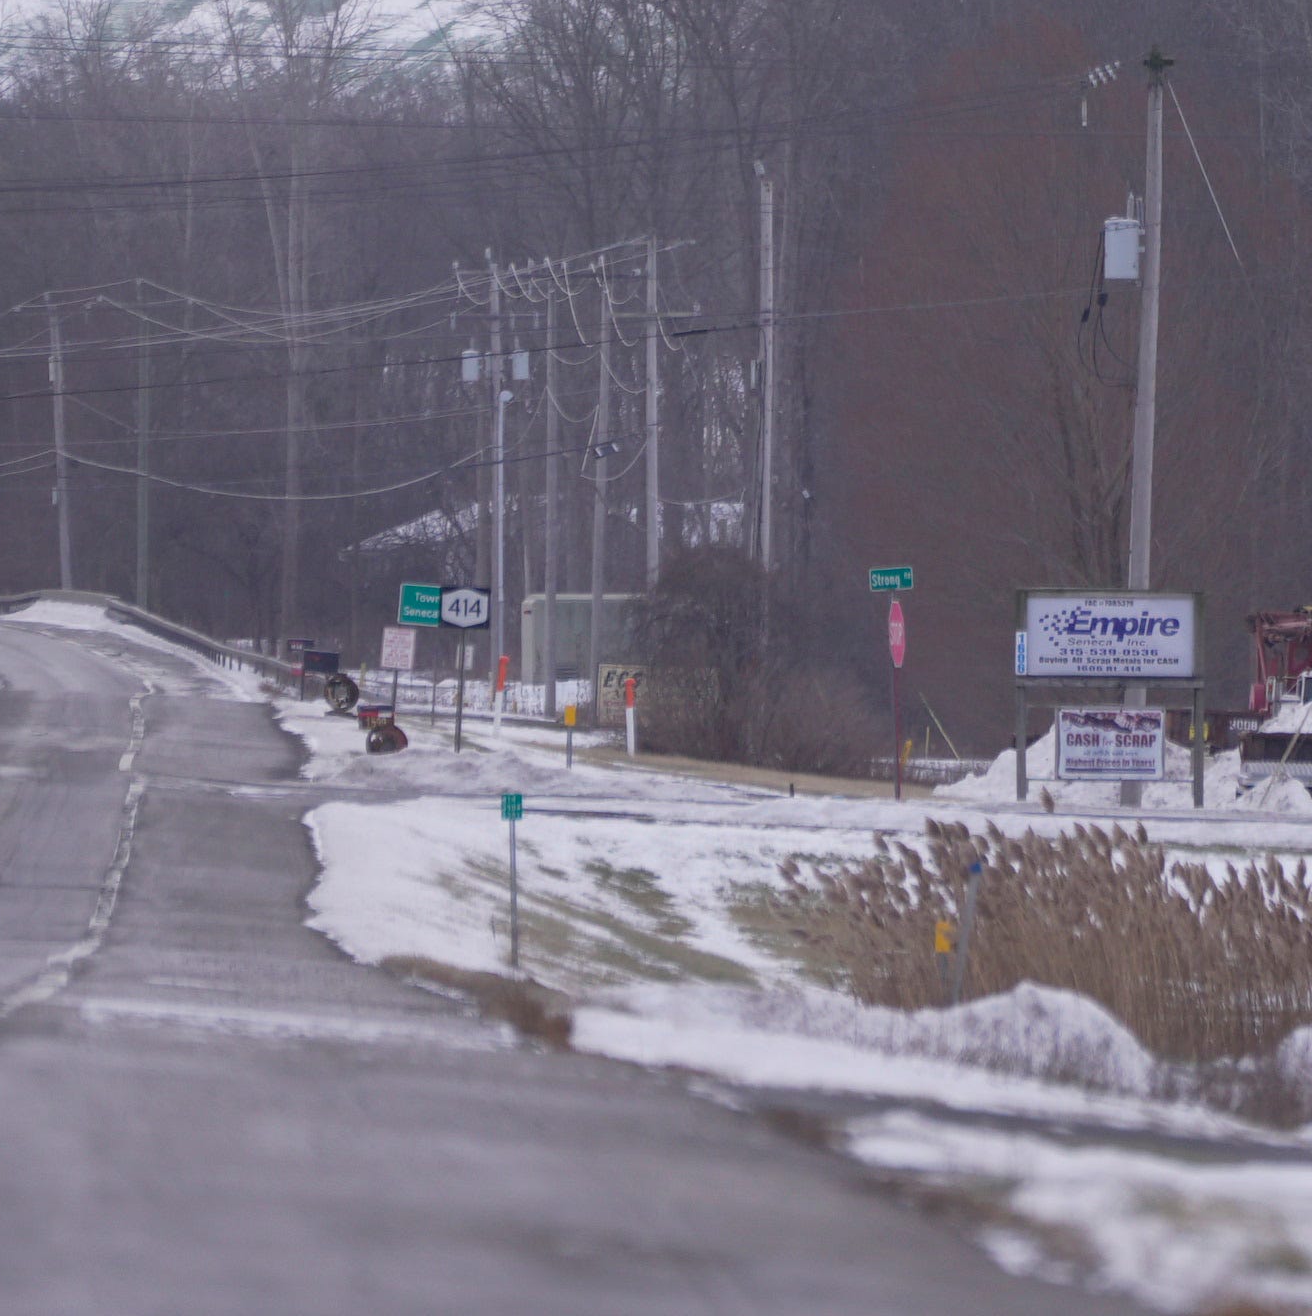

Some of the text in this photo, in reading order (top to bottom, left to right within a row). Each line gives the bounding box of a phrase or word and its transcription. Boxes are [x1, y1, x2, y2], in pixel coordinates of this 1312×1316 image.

[872, 573, 900, 589] Strong
[403, 605, 439, 620] Seneca
[448, 598, 482, 618] 414
[1065, 610, 1181, 642] Empire
[1067, 637, 1113, 646] Seneca
[1087, 657, 1111, 665] Scrap
[1113, 657, 1142, 665] Metals
[1157, 657, 1179, 665] CASH
[1066, 733, 1100, 747] CASH
[1115, 734, 1157, 748] SCRAP
